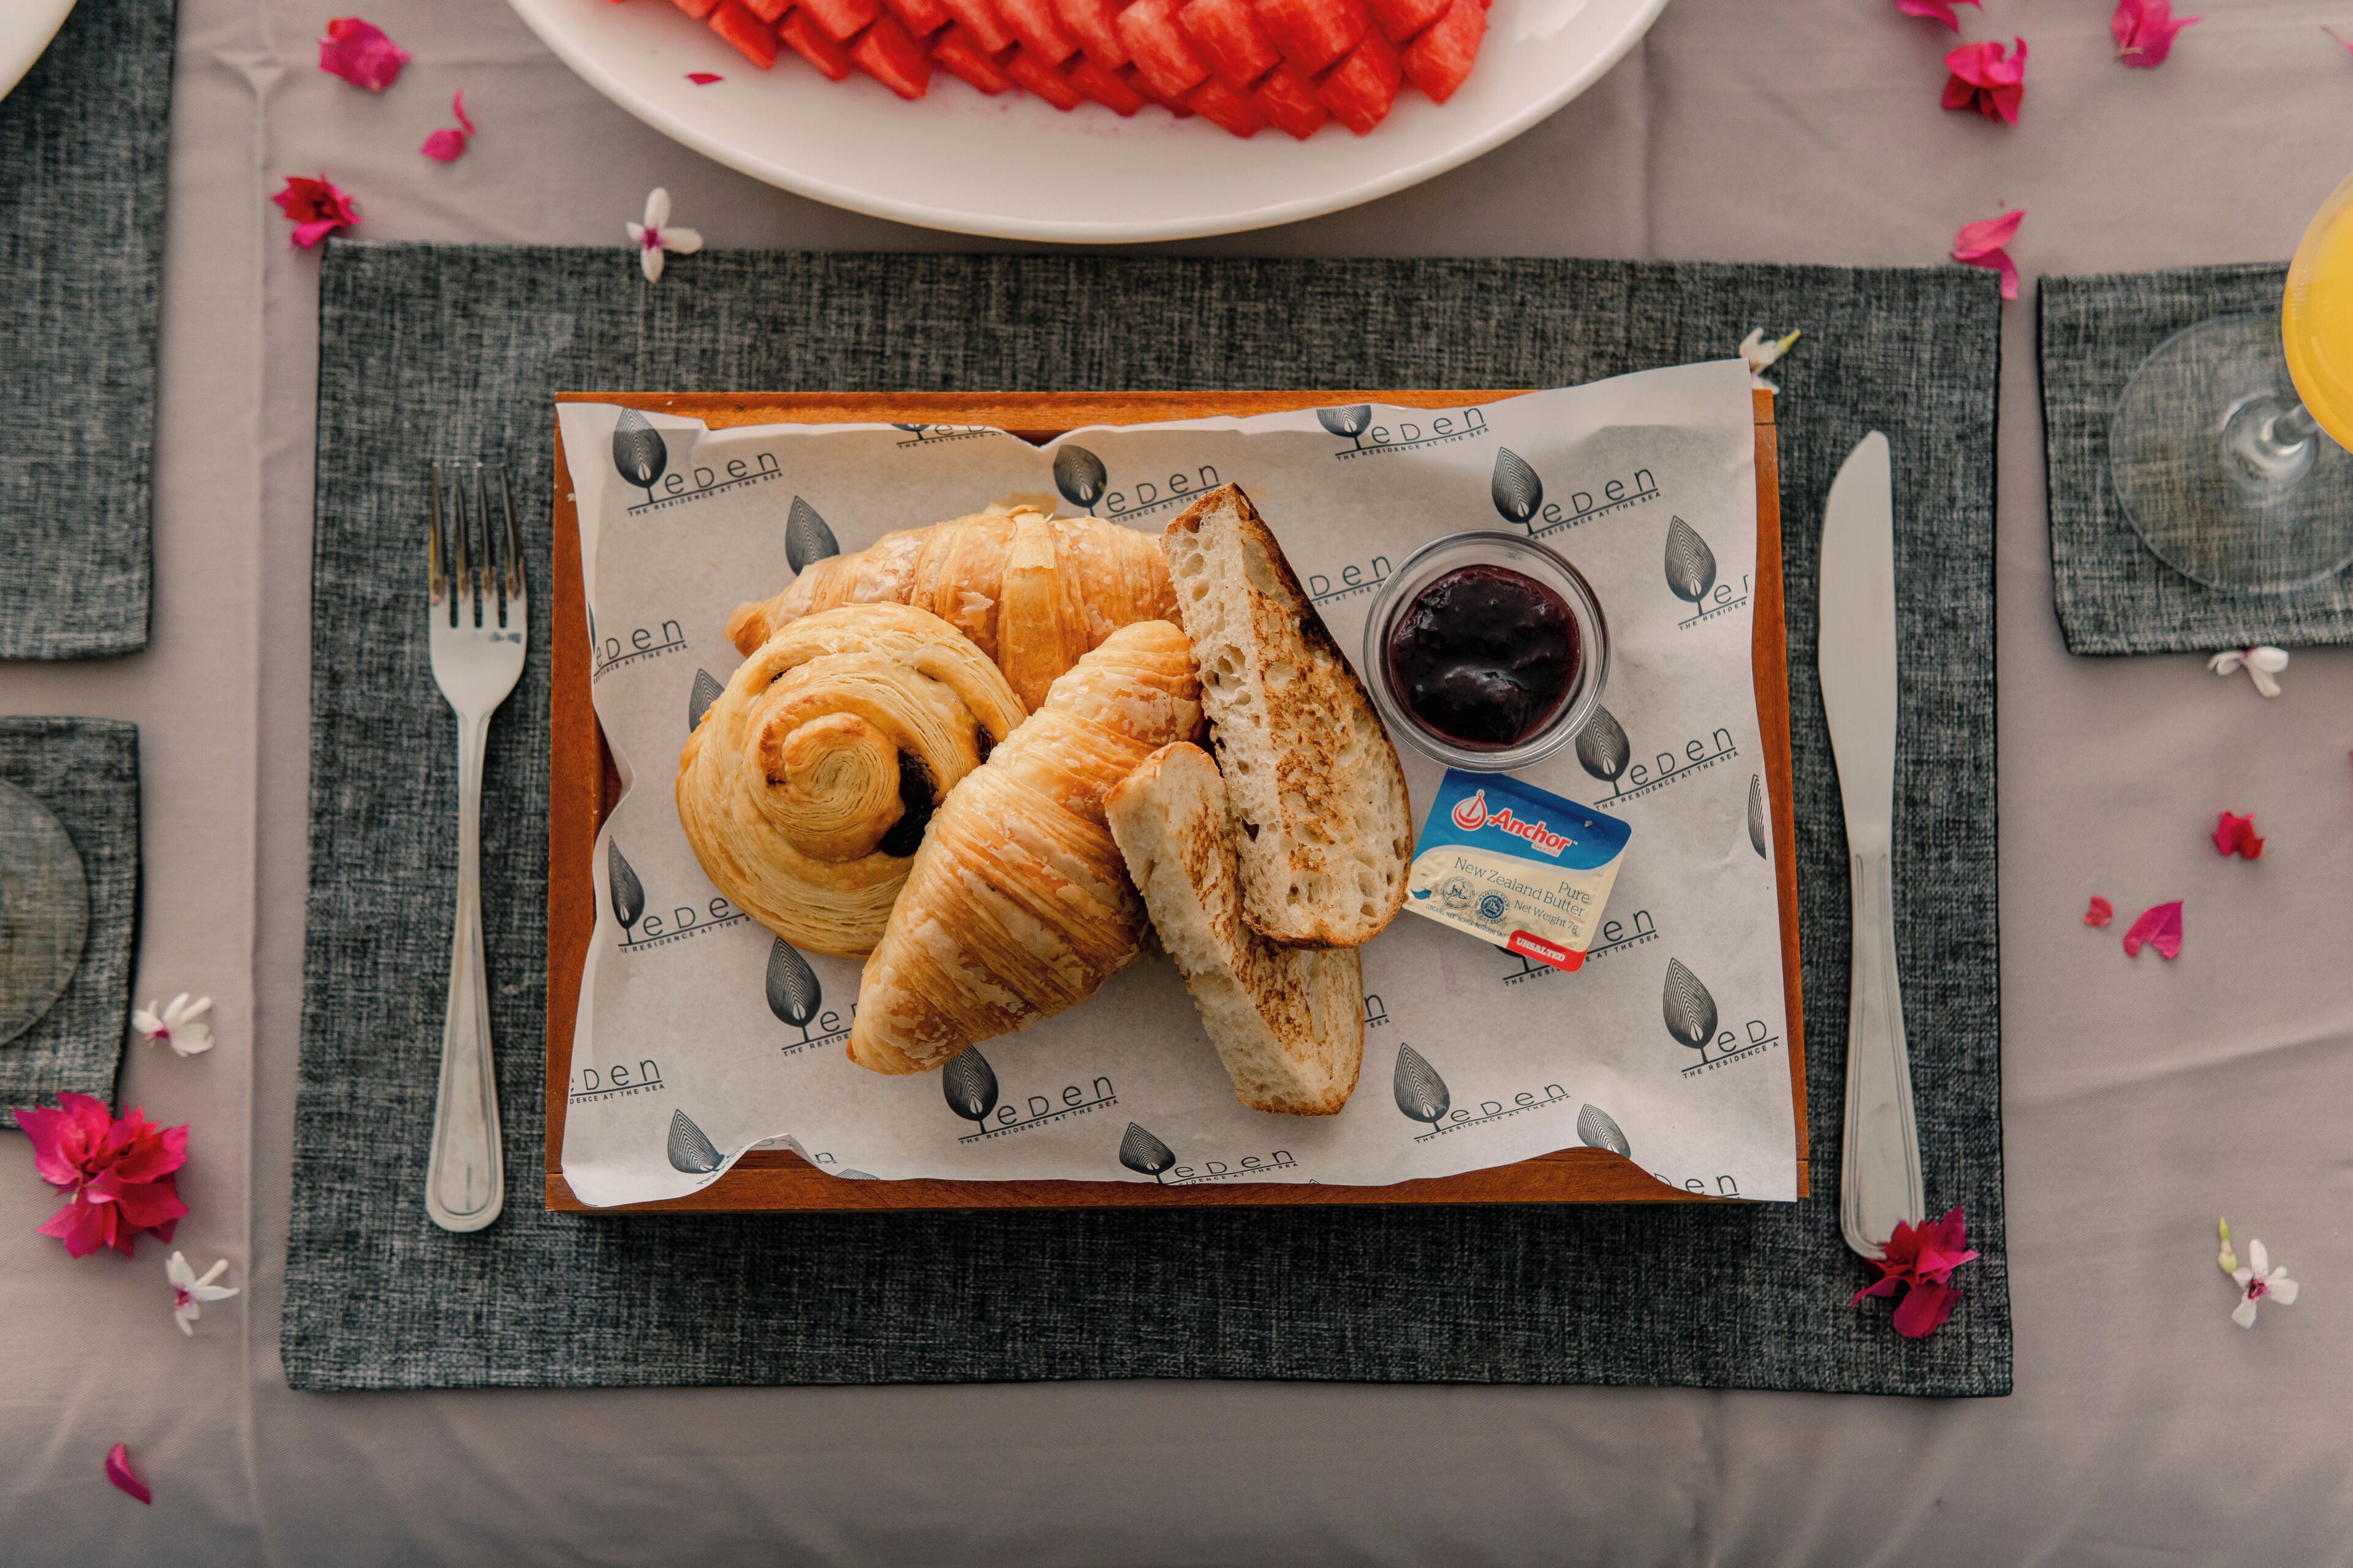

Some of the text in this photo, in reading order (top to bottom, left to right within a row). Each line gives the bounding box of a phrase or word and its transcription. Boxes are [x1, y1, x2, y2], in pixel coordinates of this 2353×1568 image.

[1337, 453, 1355, 461] THE
[1362, 444, 1420, 456] RESIDENCE
[1444, 436, 1463, 444] THE
[1469, 428, 1489, 437] SEA
[629, 508, 648, 518] THE
[654, 488, 714, 510] RESIDENCE
[738, 479, 757, 488] THE
[763, 472, 783, 482] SEA
[1599, 509, 1610, 518] AT
[1616, 501, 1635, 511] THE
[1641, 493, 1661, 503] SEA
[1352, 586, 1371, 596] THE
[1679, 600, 1746, 631] THE RESIDEN
[643, 651, 662, 661] THE
[668, 644, 688, 654] SEA
[1621, 777, 1677, 803] RESIDENCE
[1681, 770, 1692, 779] AT
[1697, 761, 1715, 771] THE
[1720, 751, 1740, 762] SEA
[1488, 808, 1571, 850] Anchor
[1454, 857, 1486, 878] New
[1487, 870, 1543, 901] Zealand
[1543, 892, 1586, 917] Butter
[1558, 881, 1591, 904] Pure
[1514, 900, 1531, 914] Net
[1533, 906, 1567, 930] Weight
[1568, 921, 1579, 934] 7g
[632, 931, 695, 952] RESIDENCE
[719, 920, 739, 929] THE
[1516, 937, 1566, 962] UNSALTED
[1504, 977, 1524, 987] THE
[1597, 950, 1608, 959] AT
[1614, 942, 1634, 952] THE
[1640, 933, 1660, 944] SEA
[1370, 1018, 1390, 1028] SEA
[784, 1032, 849, 1056] THE RESIDE
[1683, 1068, 1702, 1079] THE
[1709, 1045, 1768, 1071] RESIDENCE
[570, 1095, 598, 1104] DENCE
[645, 1083, 665, 1093] SEA
[987, 1119, 1049, 1139] RESIDENCE
[1073, 1107, 1093, 1117] THE
[1099, 1099, 1119, 1109] SEA
[1415, 1135, 1436, 1144] THE
[1441, 1115, 1503, 1135] RESIDENCE
[1552, 1095, 1571, 1104] SEA
